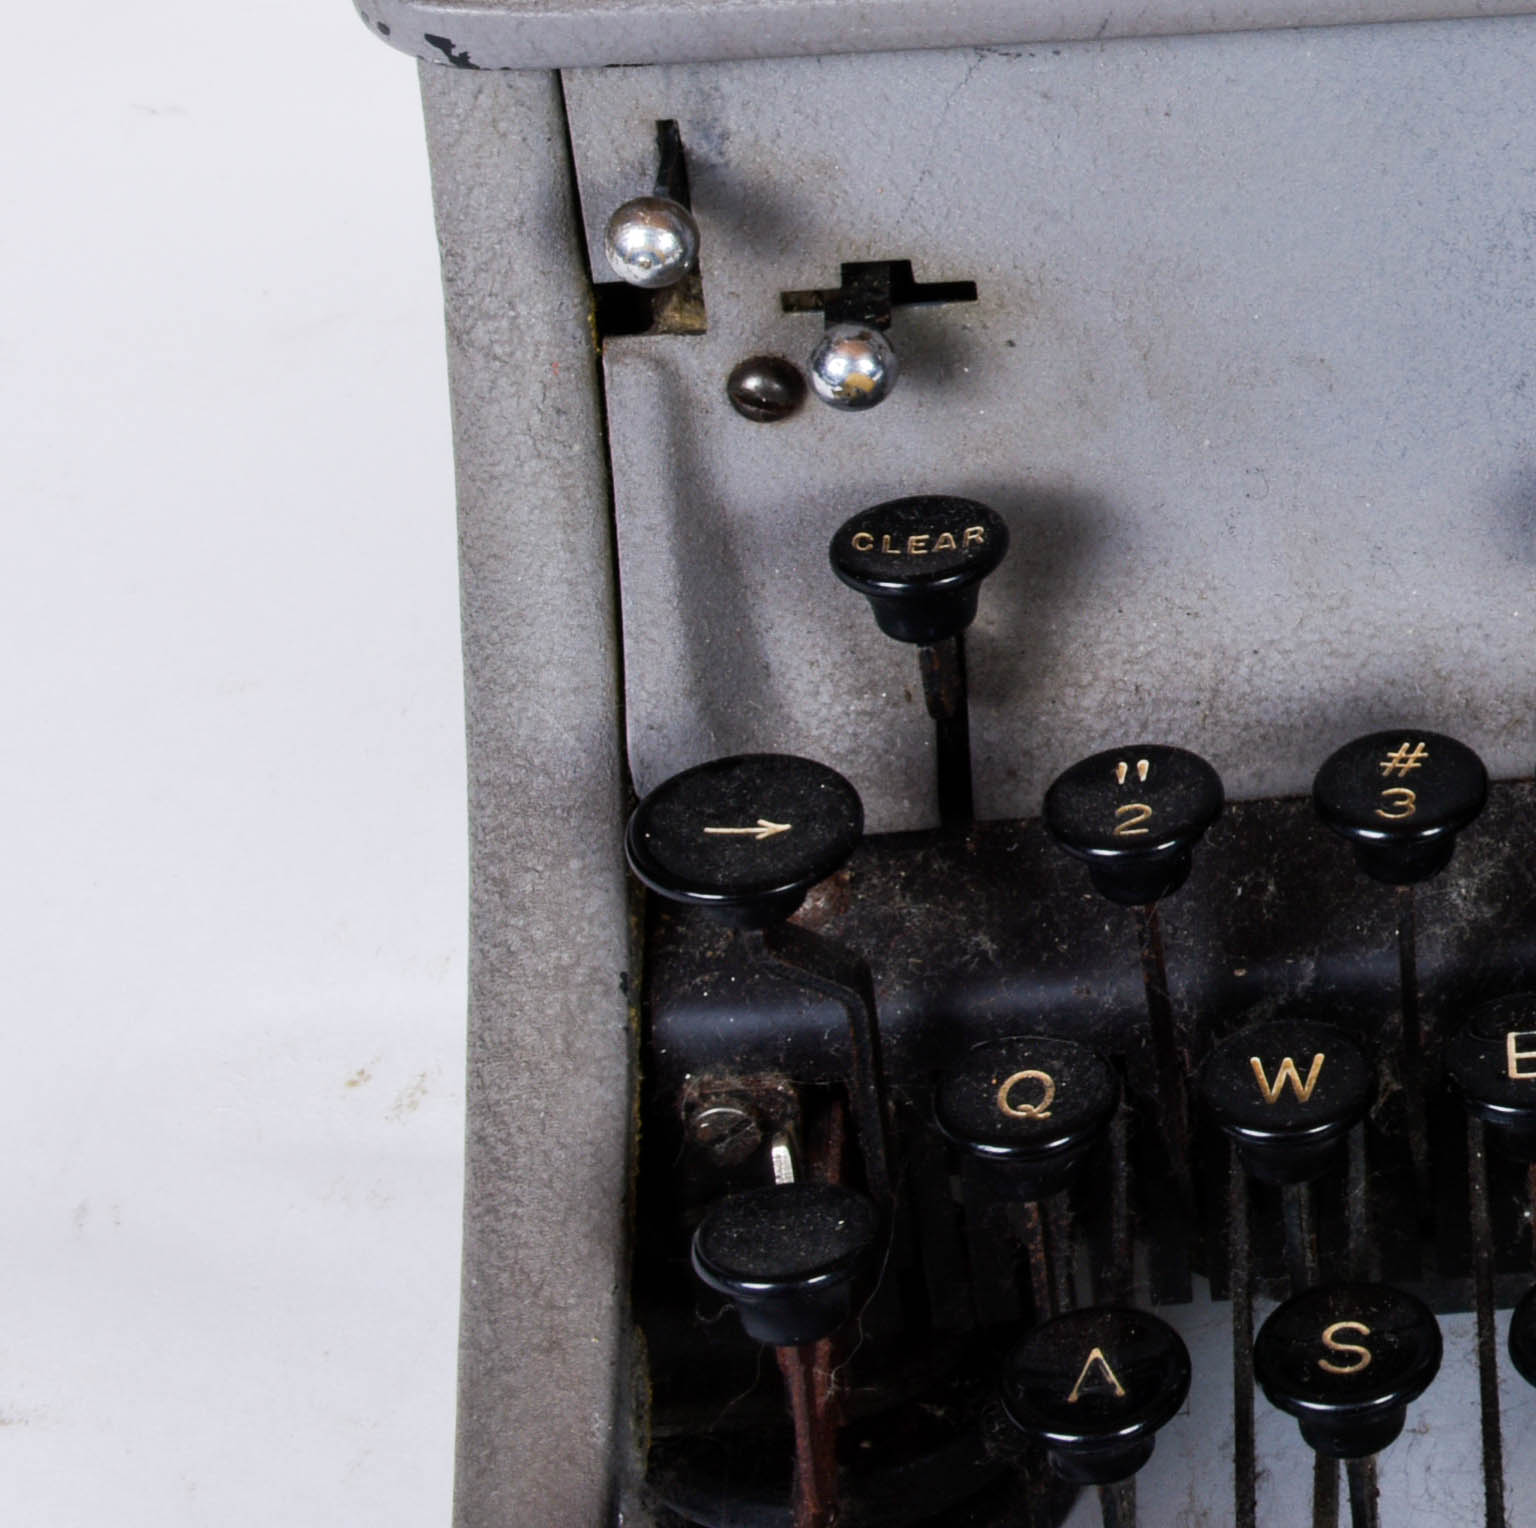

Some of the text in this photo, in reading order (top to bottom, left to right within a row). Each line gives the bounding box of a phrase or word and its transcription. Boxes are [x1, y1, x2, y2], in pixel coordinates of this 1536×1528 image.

[851, 525, 986, 555] CLEAR
[1379, 741, 1428, 776] #
[1114, 803, 1153, 836] 2
[1375, 787, 1417, 819] 3
[996, 1069, 1054, 1119] Q
[1250, 1052, 1325, 1102] W
[1318, 1321, 1372, 1374] S
[1067, 1347, 1126, 1403] A
